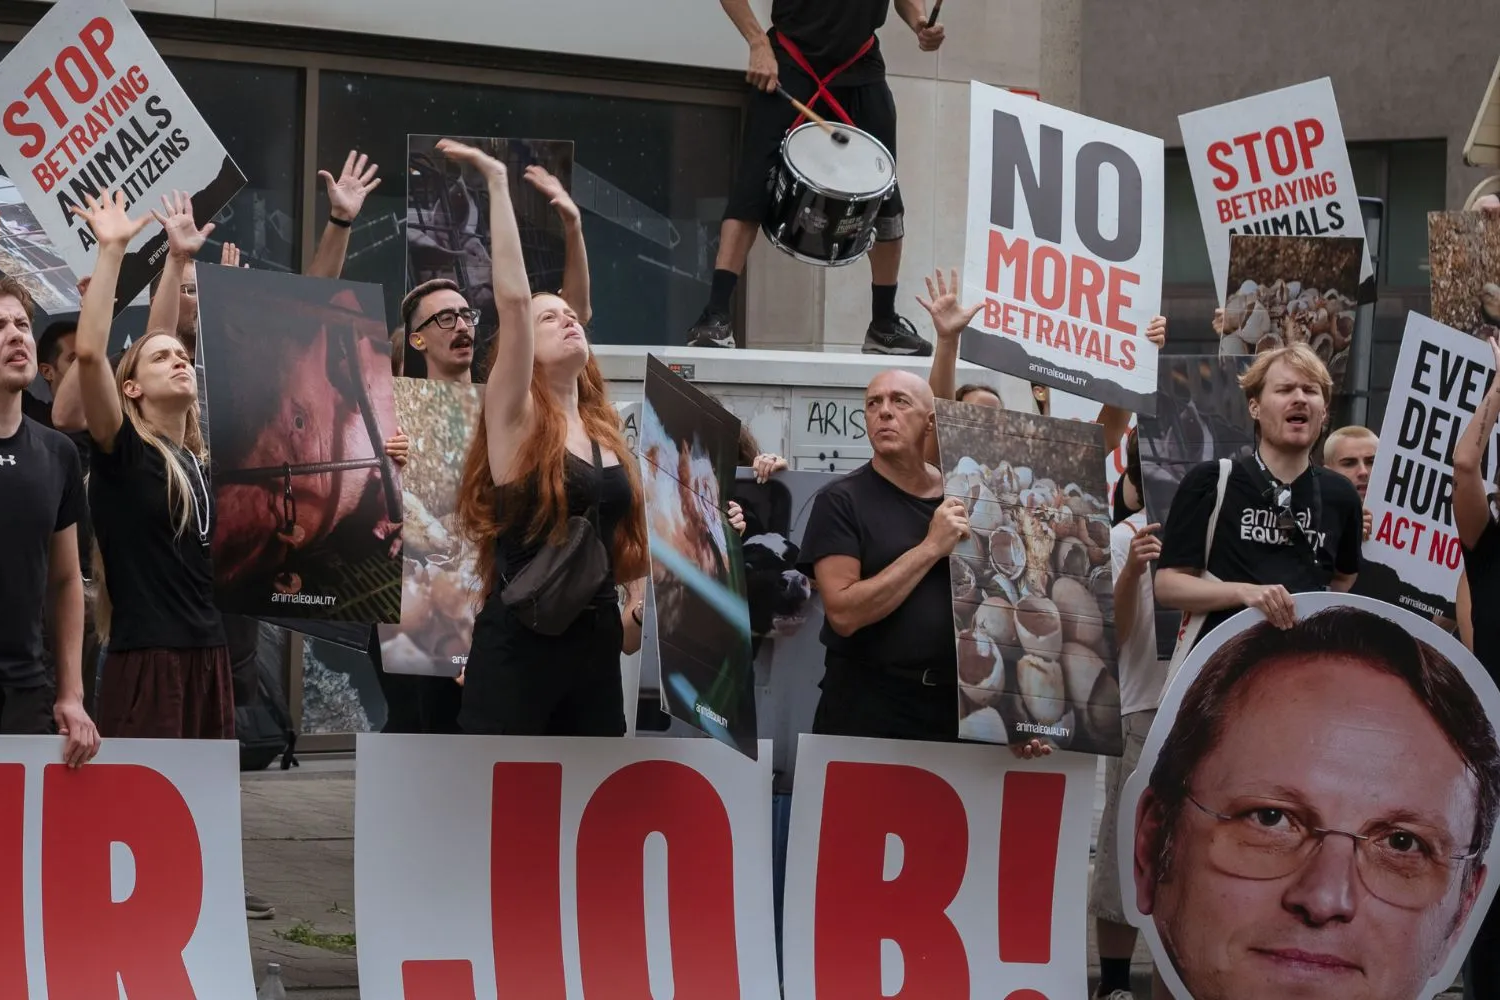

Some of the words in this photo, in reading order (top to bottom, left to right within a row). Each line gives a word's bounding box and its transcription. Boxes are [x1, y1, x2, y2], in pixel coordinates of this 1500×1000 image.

[2, 16, 116, 158] STOP
[31, 65, 150, 194] BETRAYING
[56, 95, 172, 227] ANIMALS
[1206, 118, 1325, 192] STOP
[112, 128, 190, 214] CITIZENS
[990, 109, 1143, 263] NO
[1216, 171, 1337, 224] BETRAYING
[1228, 201, 1345, 237] IMALS
[985, 229, 1141, 337] MORE
[983, 297, 1136, 371] BETRAYALS
[1028, 361, 1088, 387] animalEQUALITY
[1411, 340, 1496, 414] EVE
[1240, 506, 1292, 530] anial
[1240, 524, 1326, 548] EQUTY
[1375, 511, 1426, 555] ACT
[271, 590, 337, 606] animalEQUALITY
[1016, 721, 1070, 737] animalEQUALITY
